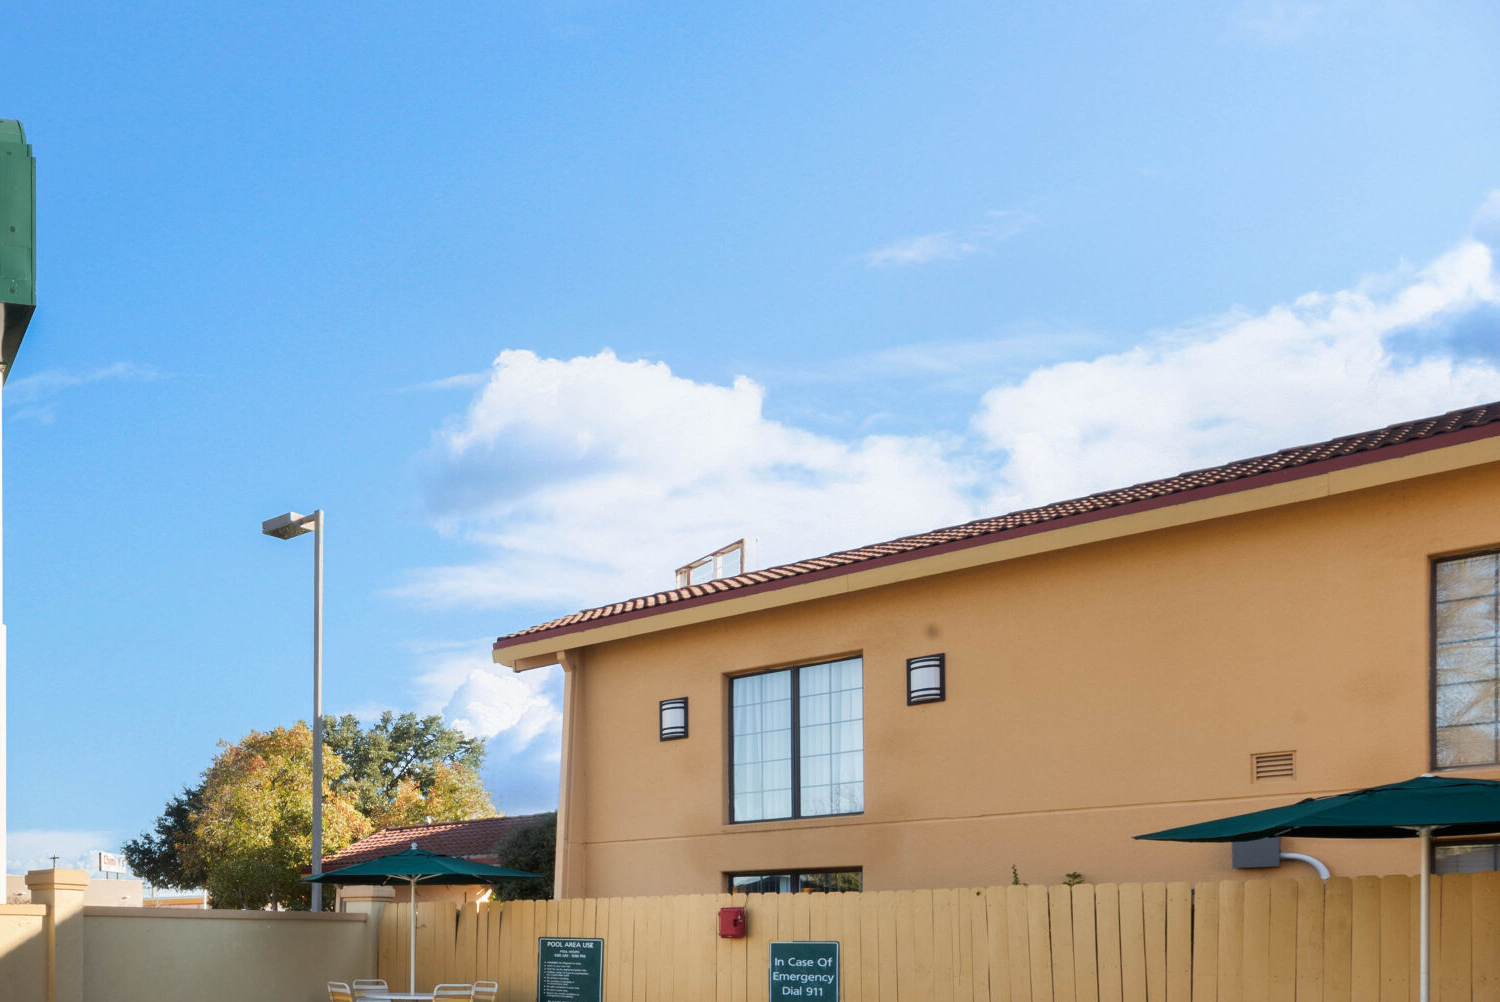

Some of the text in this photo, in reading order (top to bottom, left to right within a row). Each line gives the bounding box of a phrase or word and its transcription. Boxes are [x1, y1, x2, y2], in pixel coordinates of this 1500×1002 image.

[774, 957, 833, 967] In Case Of
[772, 971, 834, 985] Emergency
[782, 986, 823, 997] Dial 911
